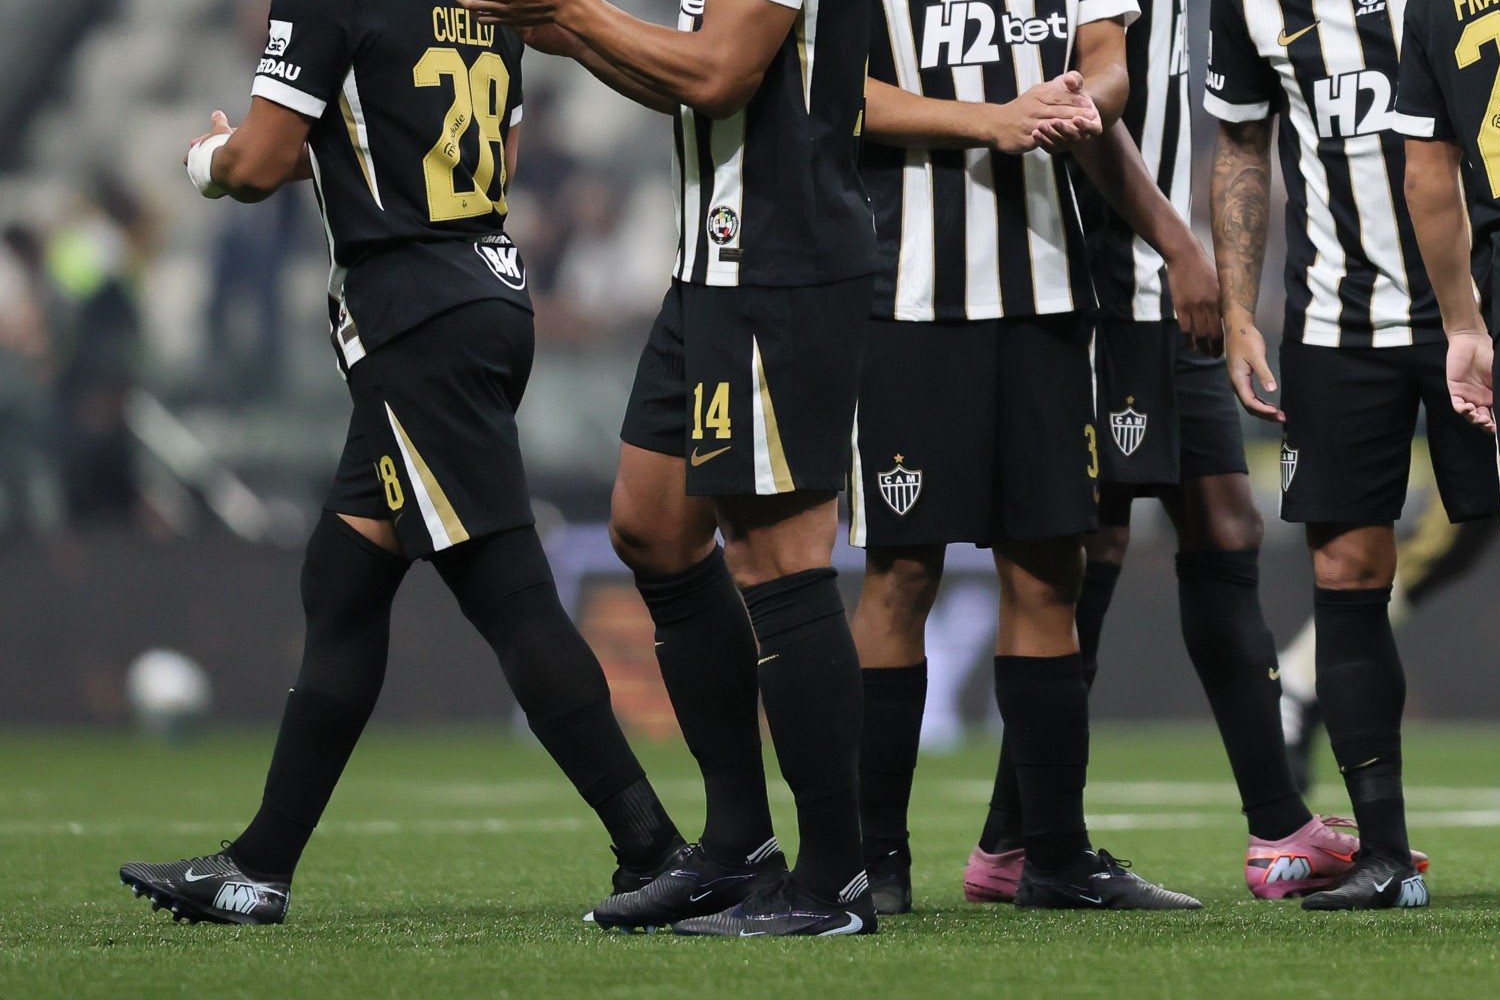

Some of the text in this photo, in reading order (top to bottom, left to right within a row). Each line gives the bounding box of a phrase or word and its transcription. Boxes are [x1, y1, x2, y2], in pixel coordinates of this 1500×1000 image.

[1356, 2, 1386, 16] ALE
[413, 47, 510, 222] 28
[692, 382, 731, 439] 14
[1116, 416, 1143, 425] CAM
[884, 475, 916, 485] CAM
